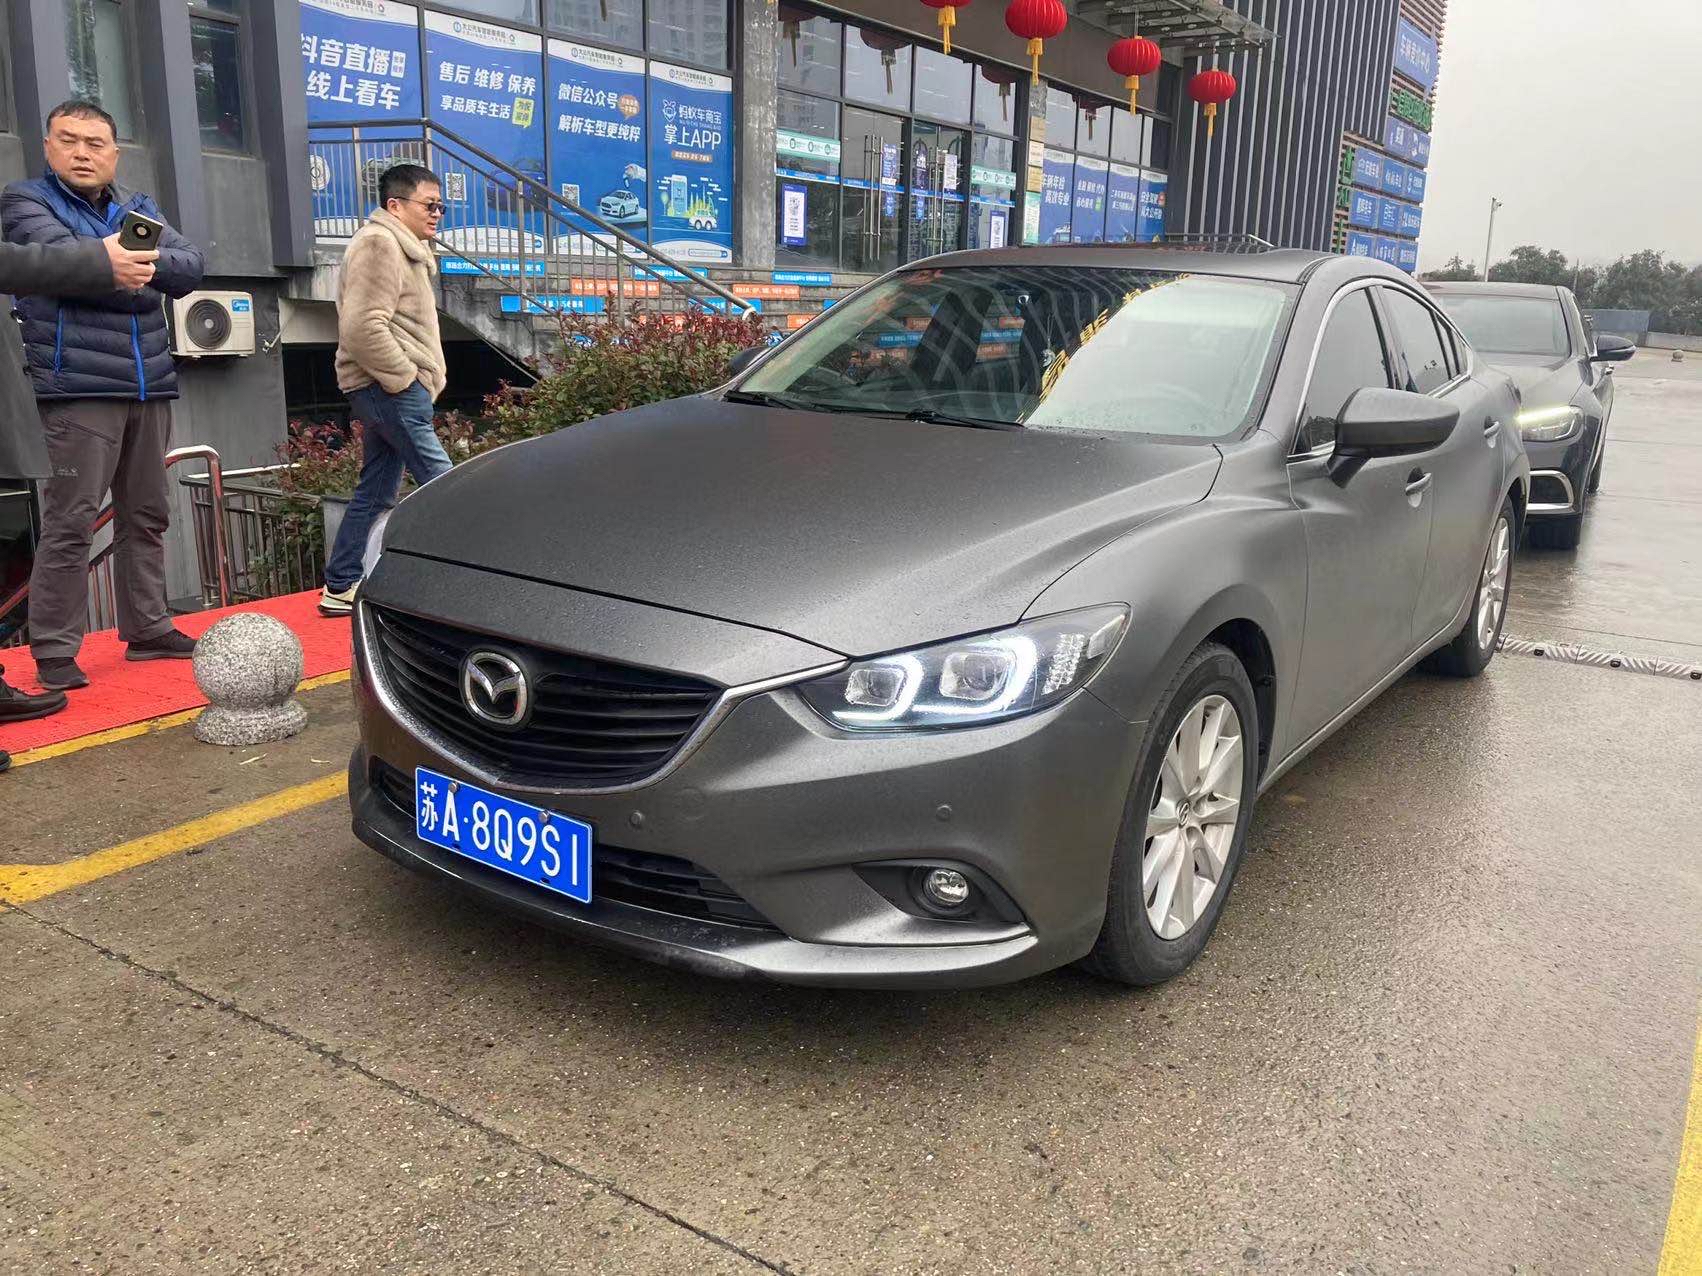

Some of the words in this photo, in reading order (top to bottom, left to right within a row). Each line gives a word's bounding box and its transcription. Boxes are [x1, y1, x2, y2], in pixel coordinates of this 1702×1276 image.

[306, 70, 401, 110] 线上看车
[439, 61, 471, 84] 售后
[473, 68, 504, 90] 维修
[507, 74, 536, 96] 保养
[440, 95, 512, 119] 享品质车生活
[558, 82, 618, 109] 微信公众号
[558, 114, 641, 142] 解析车型更纯粹
[664, 124, 722, 150] 掌上APP
